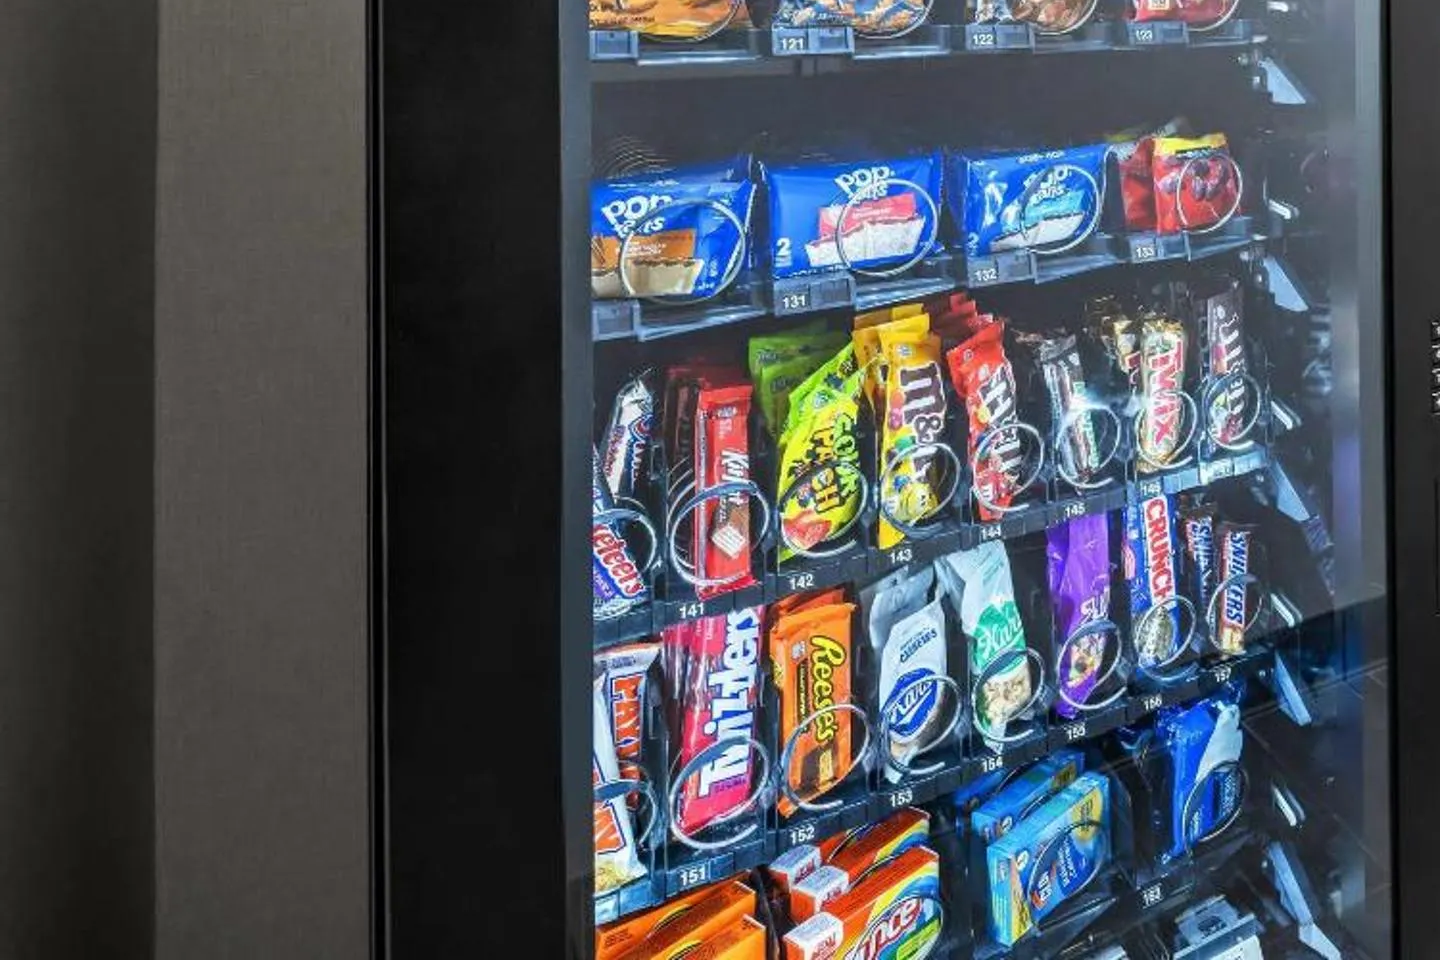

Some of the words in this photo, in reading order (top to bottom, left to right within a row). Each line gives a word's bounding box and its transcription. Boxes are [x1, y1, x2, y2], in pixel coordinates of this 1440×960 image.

[781, 37, 804, 51] 121
[972, 34, 993, 46] 122
[776, 237, 791, 256] 2
[974, 268, 997, 282] 132
[782, 294, 806, 309] 131
[1149, 340, 1185, 446] TWIX
[812, 428, 842, 513] PACH
[1064, 504, 1086, 518] 145
[889, 548, 913, 564] 143
[1145, 498, 1175, 602] CRUNCH
[789, 573, 815, 590] 142
[678, 603, 705, 620] 141
[810, 635, 847, 743] Reese's
[889, 790, 913, 807] 153
[789, 826, 815, 844] 152
[679, 865, 706, 886] 151
